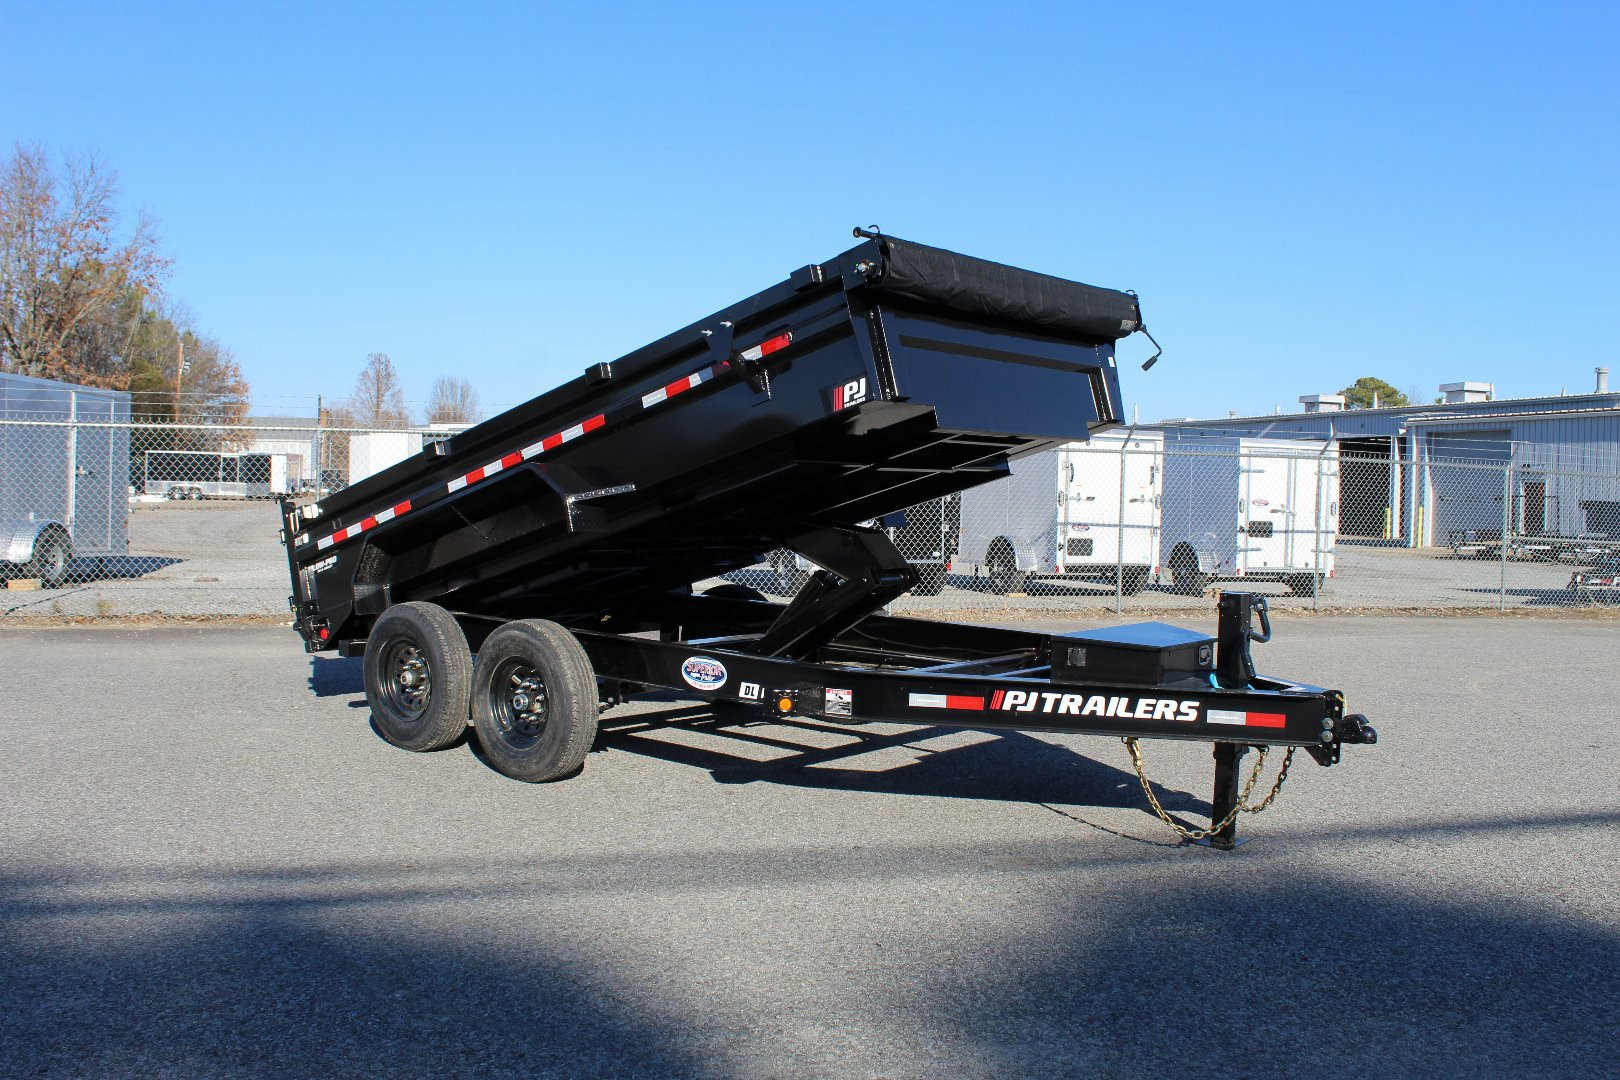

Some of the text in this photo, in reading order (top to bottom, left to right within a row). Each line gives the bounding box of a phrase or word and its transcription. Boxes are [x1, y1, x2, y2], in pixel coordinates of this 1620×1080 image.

[844, 377, 866, 404] PJ
[1002, 690, 1200, 722] PJ TRAILERS
